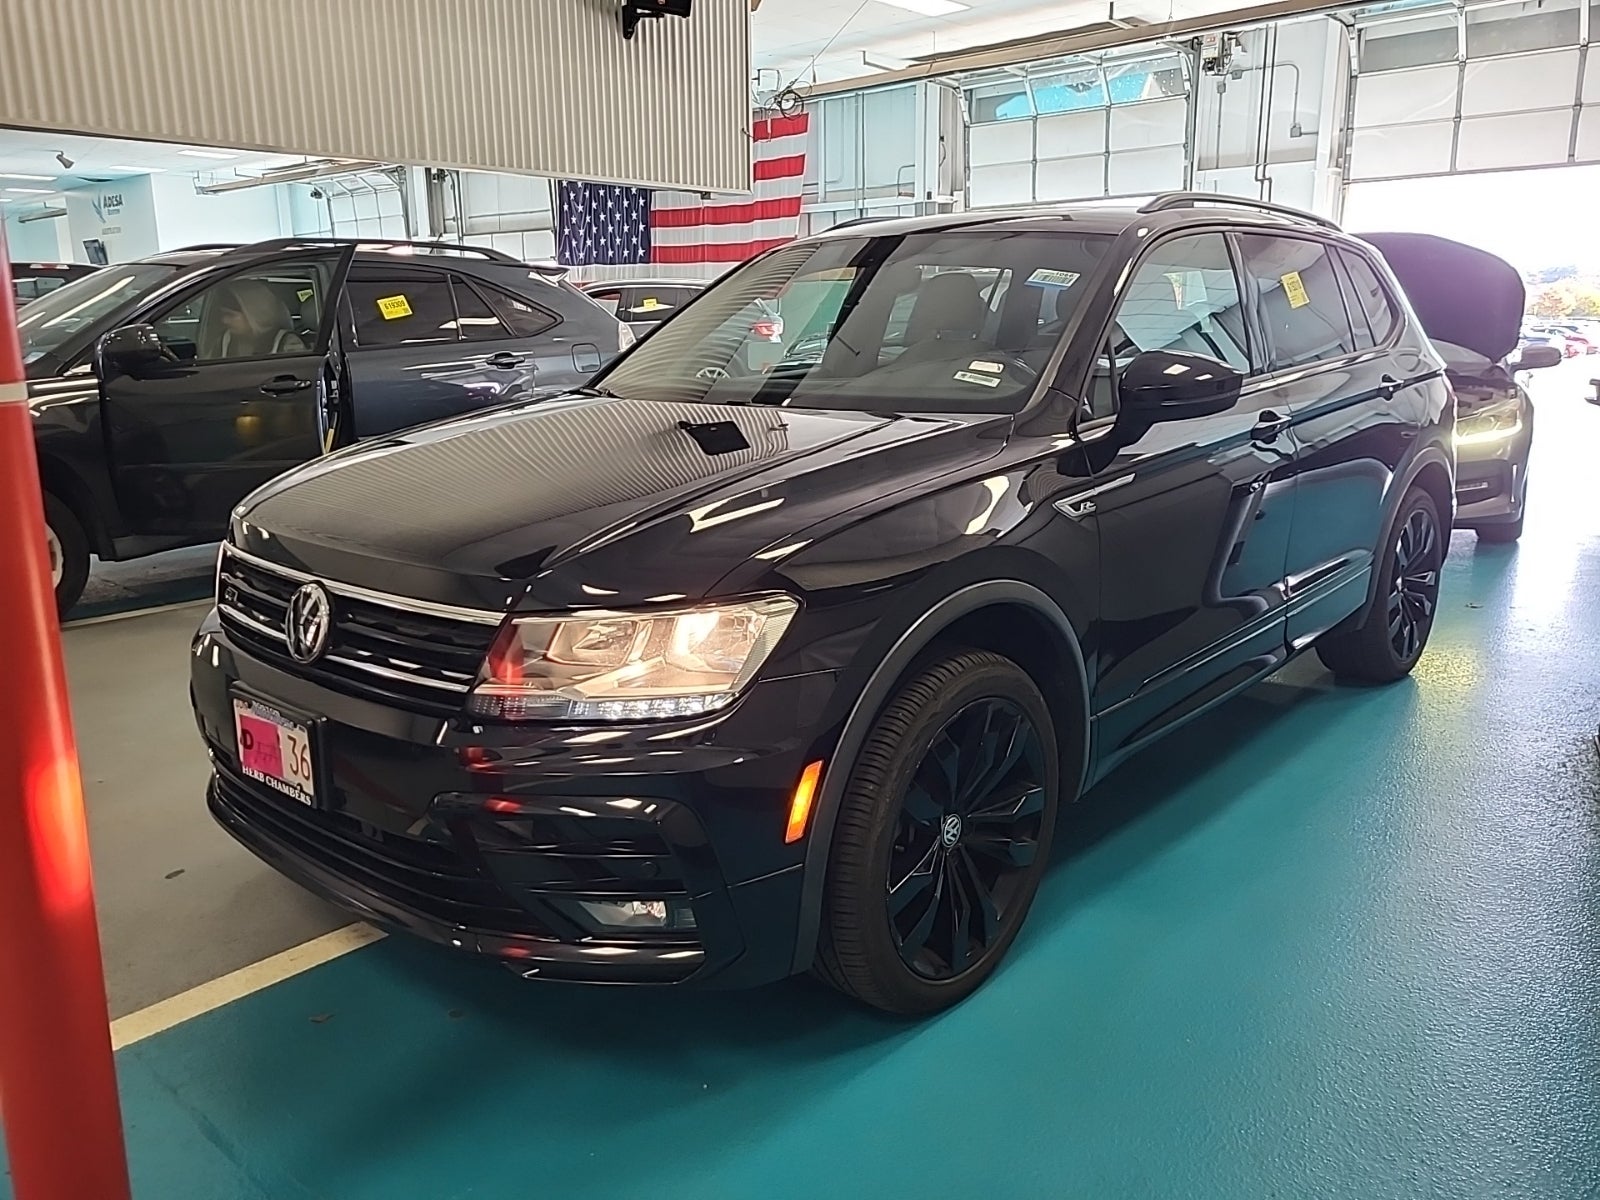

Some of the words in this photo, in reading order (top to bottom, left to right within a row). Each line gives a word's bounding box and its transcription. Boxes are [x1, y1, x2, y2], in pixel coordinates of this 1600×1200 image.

[103, 194, 124, 209] ADESA
[287, 733, 311, 781] 36
[242, 766, 265, 782] HERB
[265, 776, 312, 806] CHAMBERS
